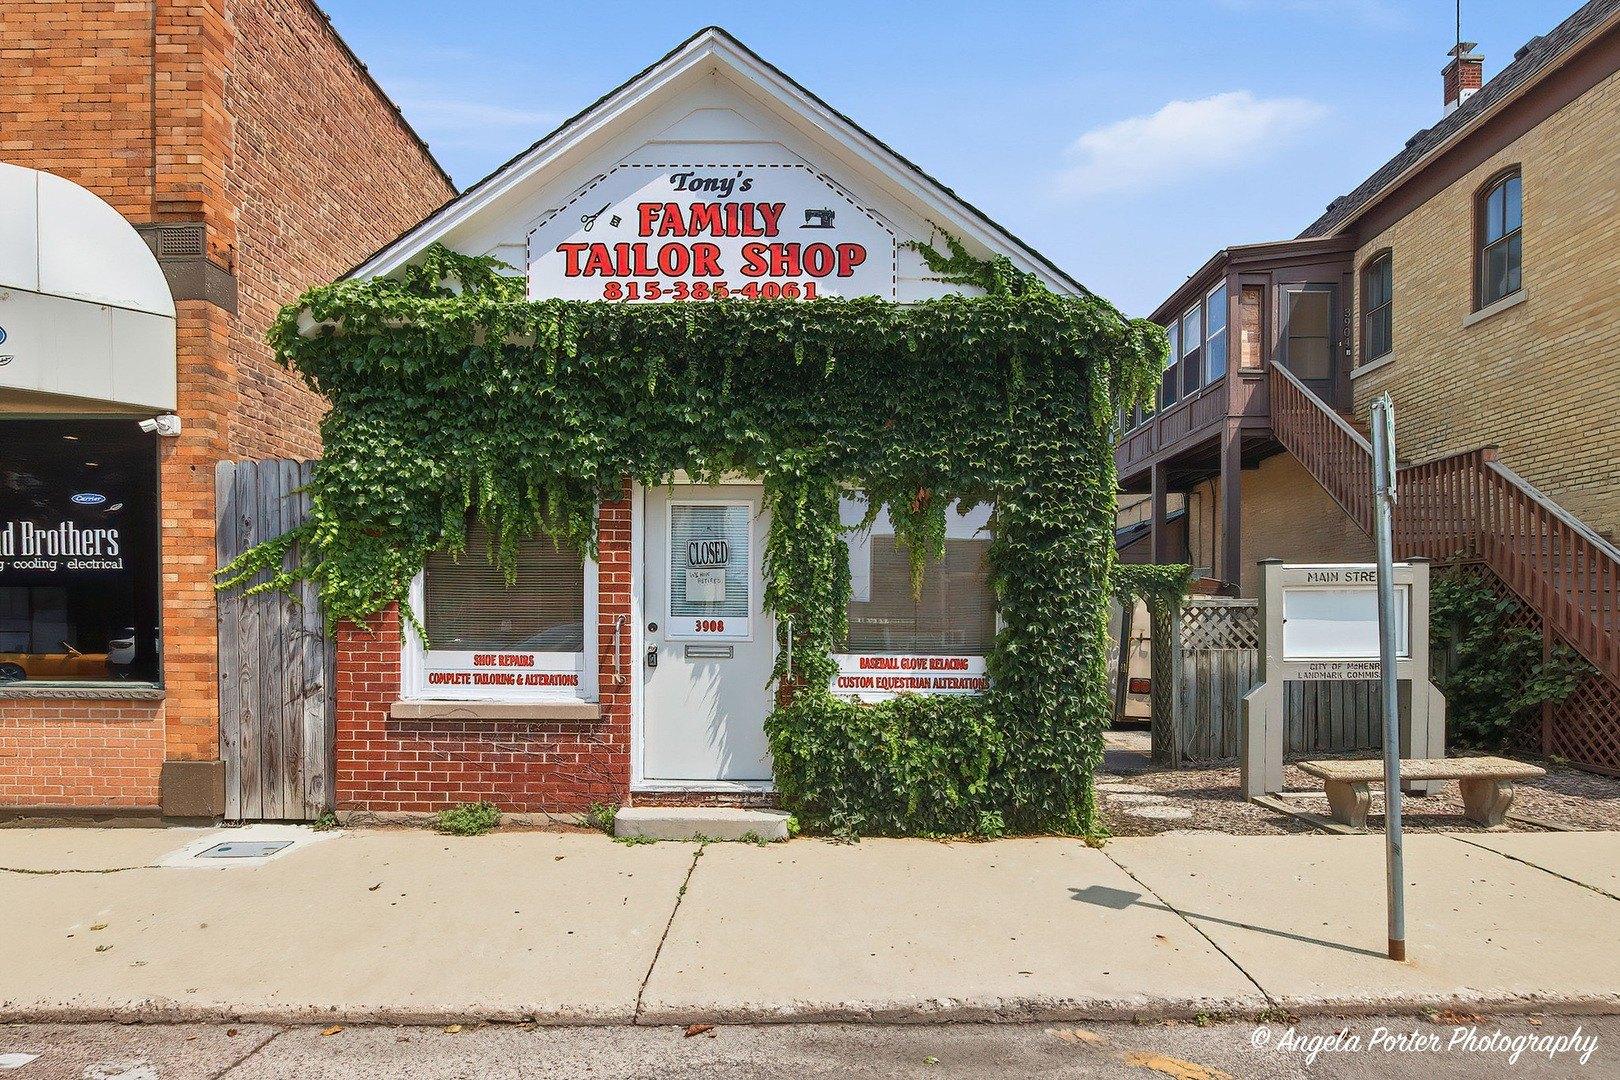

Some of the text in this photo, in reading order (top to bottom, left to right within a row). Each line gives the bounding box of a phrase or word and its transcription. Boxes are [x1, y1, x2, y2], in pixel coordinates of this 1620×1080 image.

[669, 170, 754, 199] Tony's
[637, 202, 787, 238] FAMILY
[556, 242, 868, 278] TAILOR SHOP
[602, 281, 819, 301] 815-385-4061
[20, 520, 120, 557] Brothers
[688, 540, 729, 567] CLOSED
[13, 557, 58, 572] cooling
[67, 557, 124, 570] electrical
[1307, 571, 1377, 583] MAIN STRE
[695, 620, 725, 633] 3908
[473, 654, 535, 667] SHOE REPAIRS
[859, 657, 970, 671] BASEBALL GLOVE RELACING
[1309, 662, 1328, 671] CITY
[1347, 662, 1380, 670] McHENR
[428, 672, 579, 687] COMPLETE TAILORING & ALTERATIONS
[1297, 671, 1380, 679] LANDMARK COMMIS
[837, 676, 875, 689] CUSTOM
[876, 677, 931, 691] EQUESTRIAN
